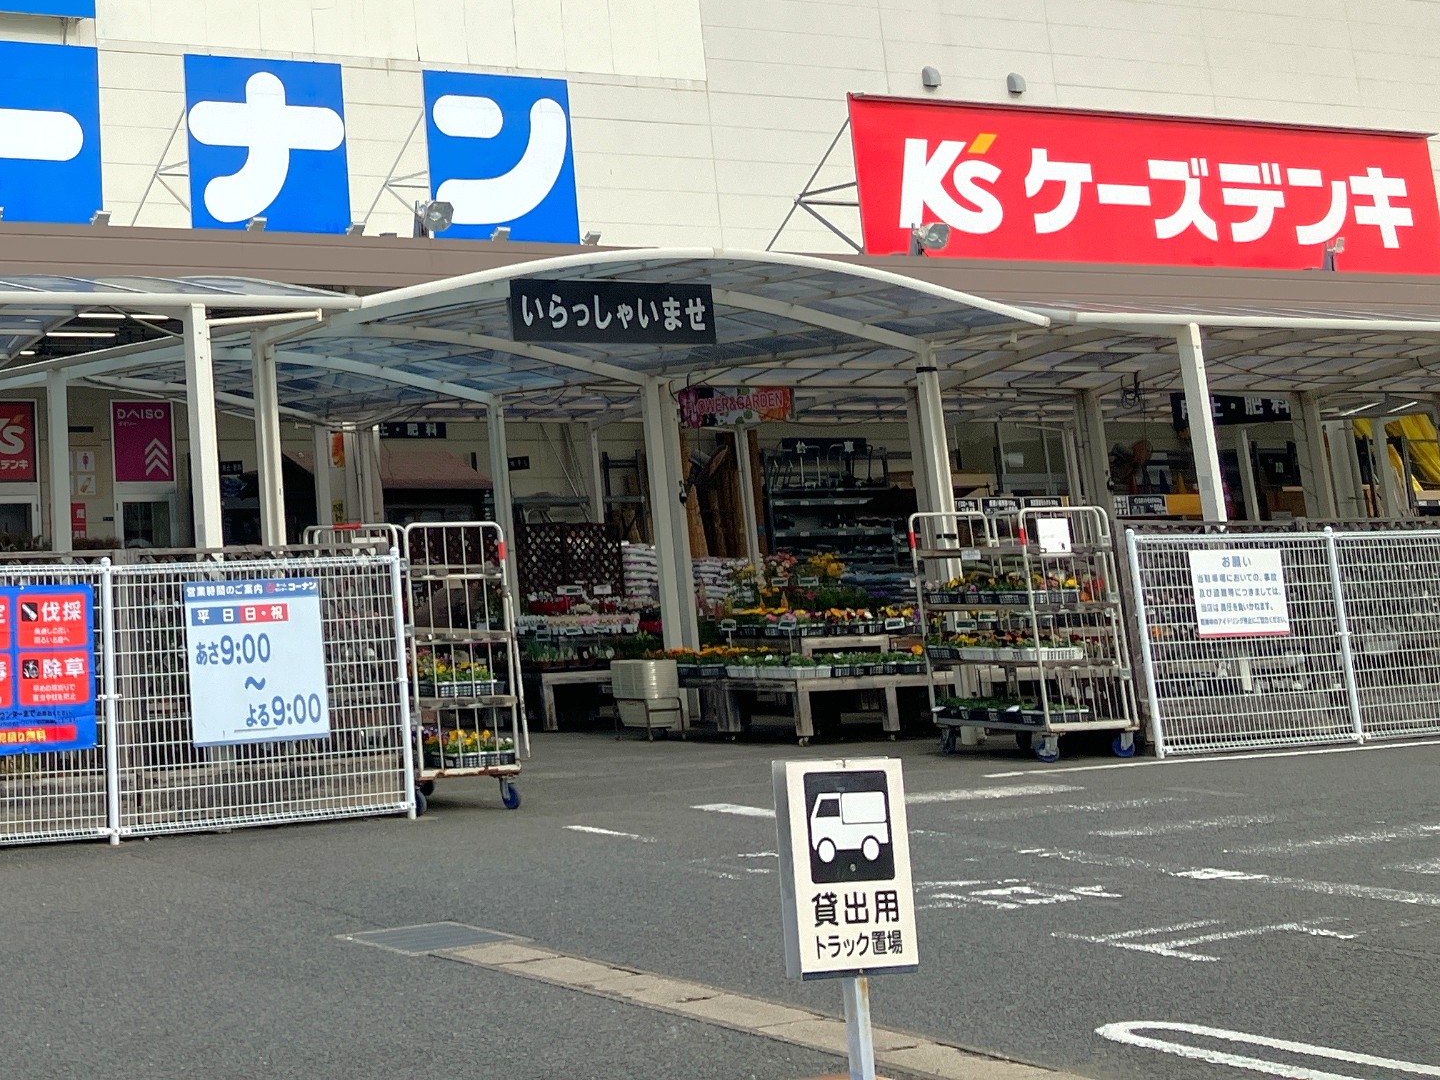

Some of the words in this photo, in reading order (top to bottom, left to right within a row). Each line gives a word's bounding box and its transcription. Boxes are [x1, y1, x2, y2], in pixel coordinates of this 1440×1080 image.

[1024, 148, 1414, 249] ケーズデンキ
[521, 293, 707, 332] いらっしゃいませ
[117, 409, 164, 420] DAISO
[1221, 556, 1252, 568] お願い
[186, 584, 264, 598] 営業時間のご案内
[288, 581, 317, 591] コーナン
[41, 600, 82, 622] 伐採
[196, 633, 271, 665] あさ9:00
[42, 657, 85, 679] 除草
[246, 693, 321, 727] よる9:00
[811, 889, 900, 928] 貸出用
[816, 929, 903, 960] トラック置場
